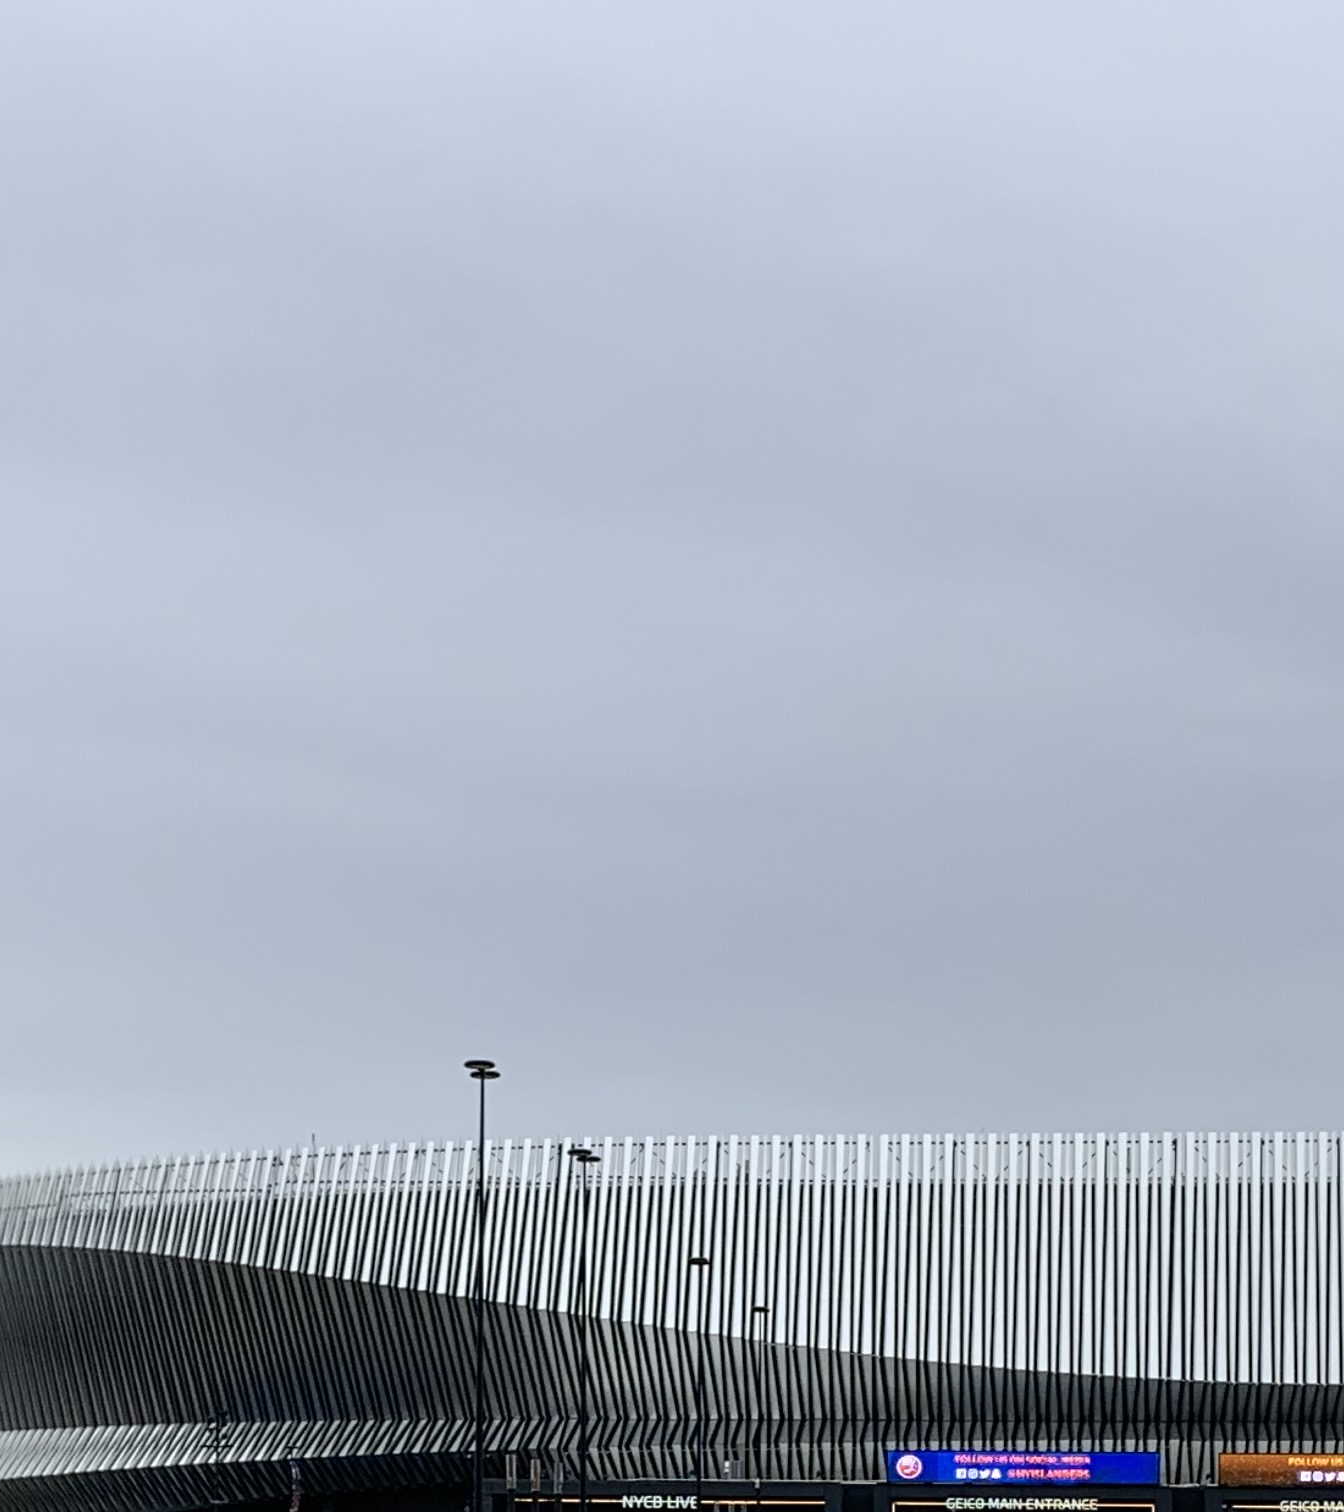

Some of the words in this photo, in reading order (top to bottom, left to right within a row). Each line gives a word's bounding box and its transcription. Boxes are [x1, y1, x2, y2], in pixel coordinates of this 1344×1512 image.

[1287, 1457, 1329, 1466] FOLLOW
[1331, 1457, 1344, 1466] US
[622, 1495, 663, 1509] NYCB
[667, 1495, 698, 1509] LIVE
[945, 1497, 985, 1510] GEICO
[988, 1498, 1023, 1510] MAIN
[1026, 1498, 1099, 1511] ENTRANCE
[1279, 1500, 1320, 1512] GEICO
